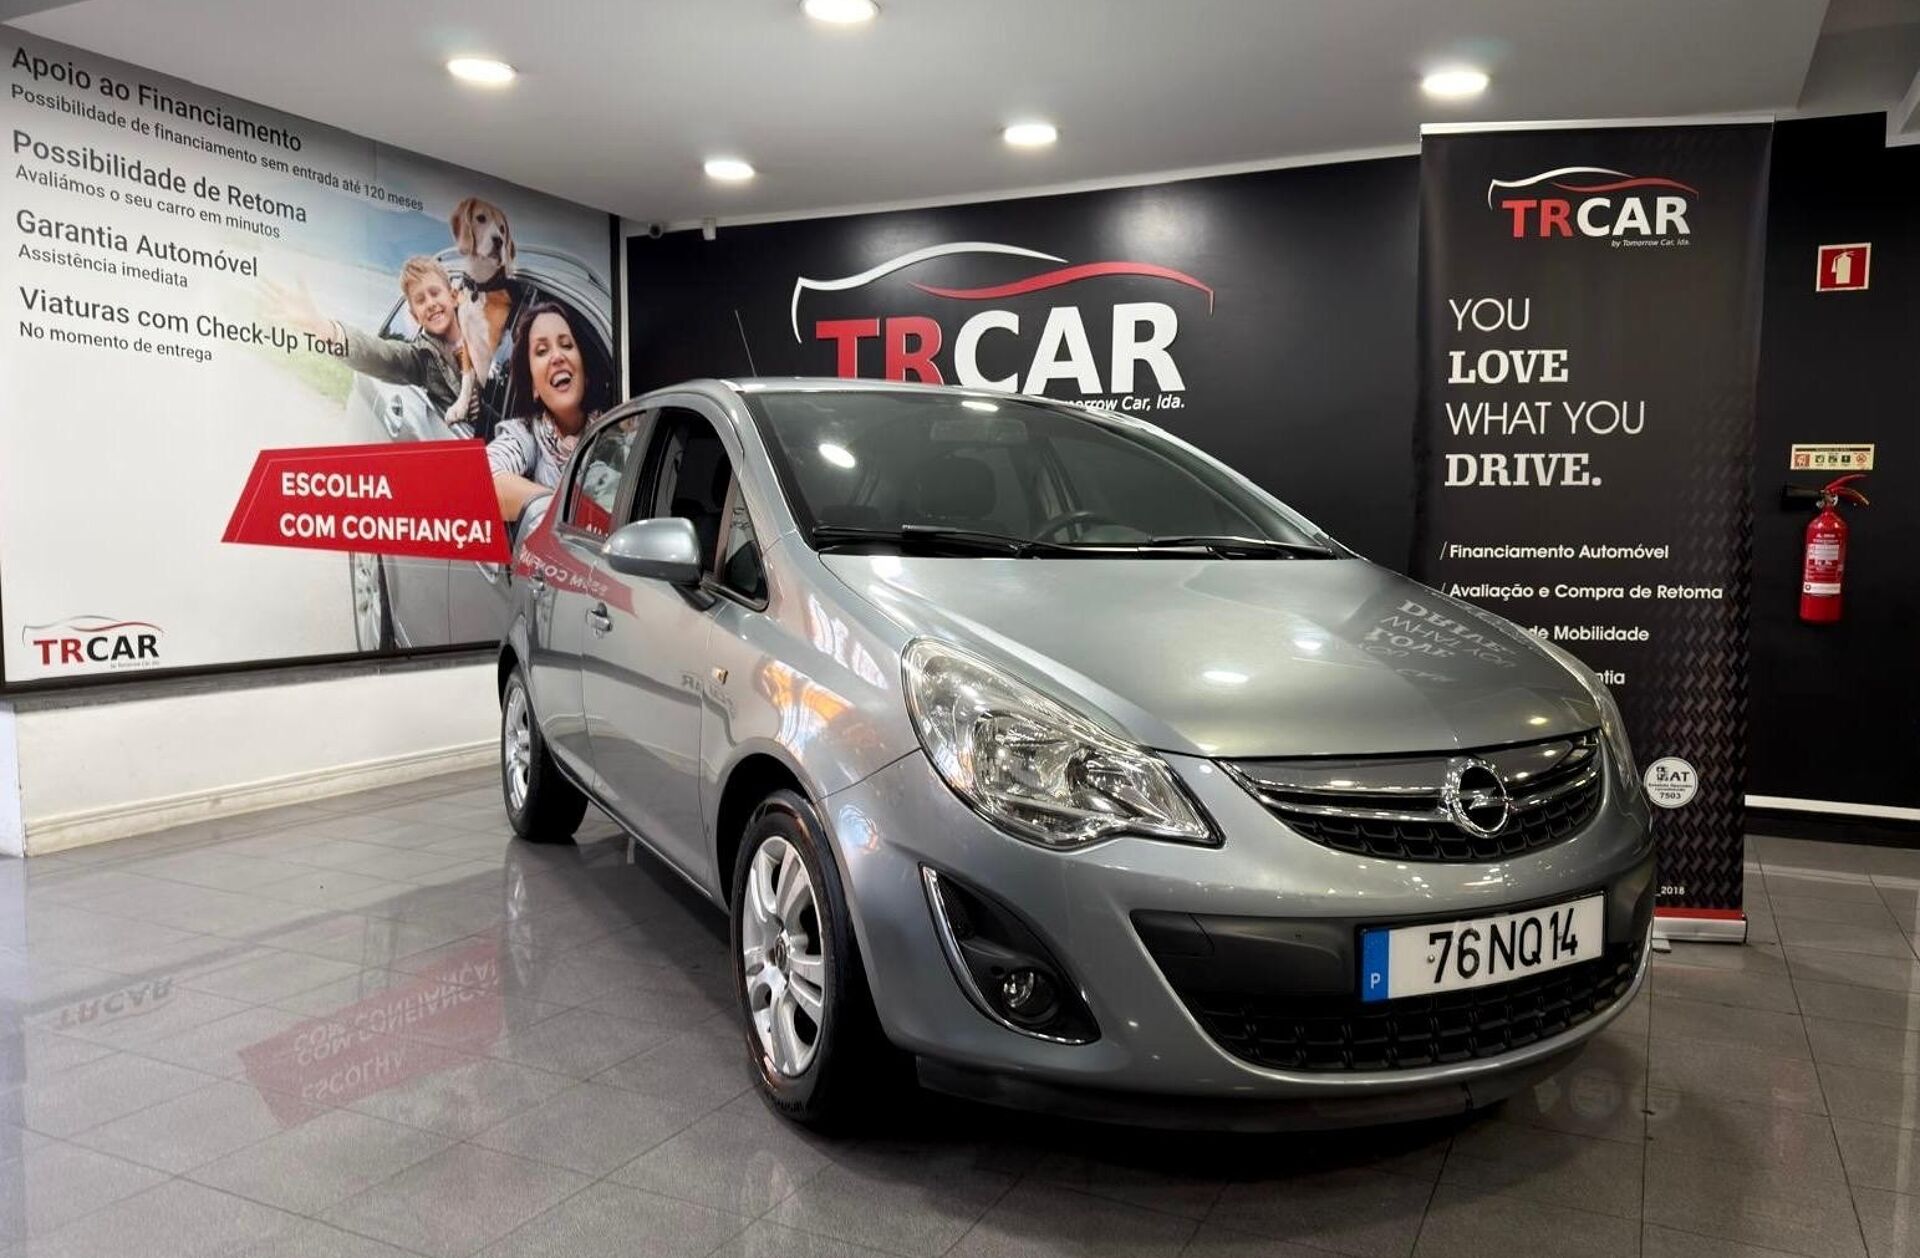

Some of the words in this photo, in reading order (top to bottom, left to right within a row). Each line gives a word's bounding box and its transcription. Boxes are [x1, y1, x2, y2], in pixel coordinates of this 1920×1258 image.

[12, 47, 91, 89] Apoio
[100, 77, 130, 101] ao
[138, 84, 302, 151] Financiamento
[11, 83, 127, 128] Possibilidade
[131, 117, 150, 135] de
[155, 122, 257, 164] financiamento
[261, 154, 289, 173] sem
[292, 165, 339, 188] entrada
[343, 179, 361, 194] até
[365, 185, 385, 200] 120
[387, 193, 424, 211] meses
[13, 129, 186, 194] Possibilidade
[193, 177, 221, 201] de
[228, 185, 307, 223] Retoma
[16, 164, 105, 198] Avaliámos
[110, 189, 120, 202] o
[125, 192, 153, 209] seu
[157, 199, 195, 219] carro
[200, 209, 222, 225] em
[225, 215, 280, 239] minutos
[1502, 196, 1691, 238] TRCAR
[16, 209, 128, 252] Garantia
[136, 234, 257, 277] Automóvel
[18, 243, 117, 275] Assistência
[122, 262, 188, 288] imediata
[19, 286, 130, 324] Viaturas
[137, 309, 189, 334] com
[196, 315, 298, 354] Check-Up
[304, 332, 349, 358] Total
[1448, 298, 1531, 331] YOU
[19, 321, 44, 339] No
[50, 327, 129, 350] momento
[133, 338, 152, 353] de
[157, 343, 213, 363] entrega
[815, 301, 1186, 396] TRCAR
[1448, 349, 1569, 384] LOVE
[1121, 396, 1151, 411] Car,
[1445, 401, 1552, 435] WHAT
[1561, 401, 1645, 434] YOU
[281, 471, 393, 499] ESCOLHA
[1444, 453, 1602, 487] DRIVE.
[279, 513, 336, 538] COM
[342, 515, 492, 549] CONFIANÇA!
[1578, 543, 1669, 559] Automóvel
[1538, 586, 1550, 598] e
[1555, 584, 1624, 600] Compra
[1629, 584, 1652, 598] de
[1657, 585, 1723, 599] Retoma
[33, 634, 160, 666] TRCAR
[1554, 625, 1650, 641] Mobilidade
[1370, 973, 1381, 989] P
